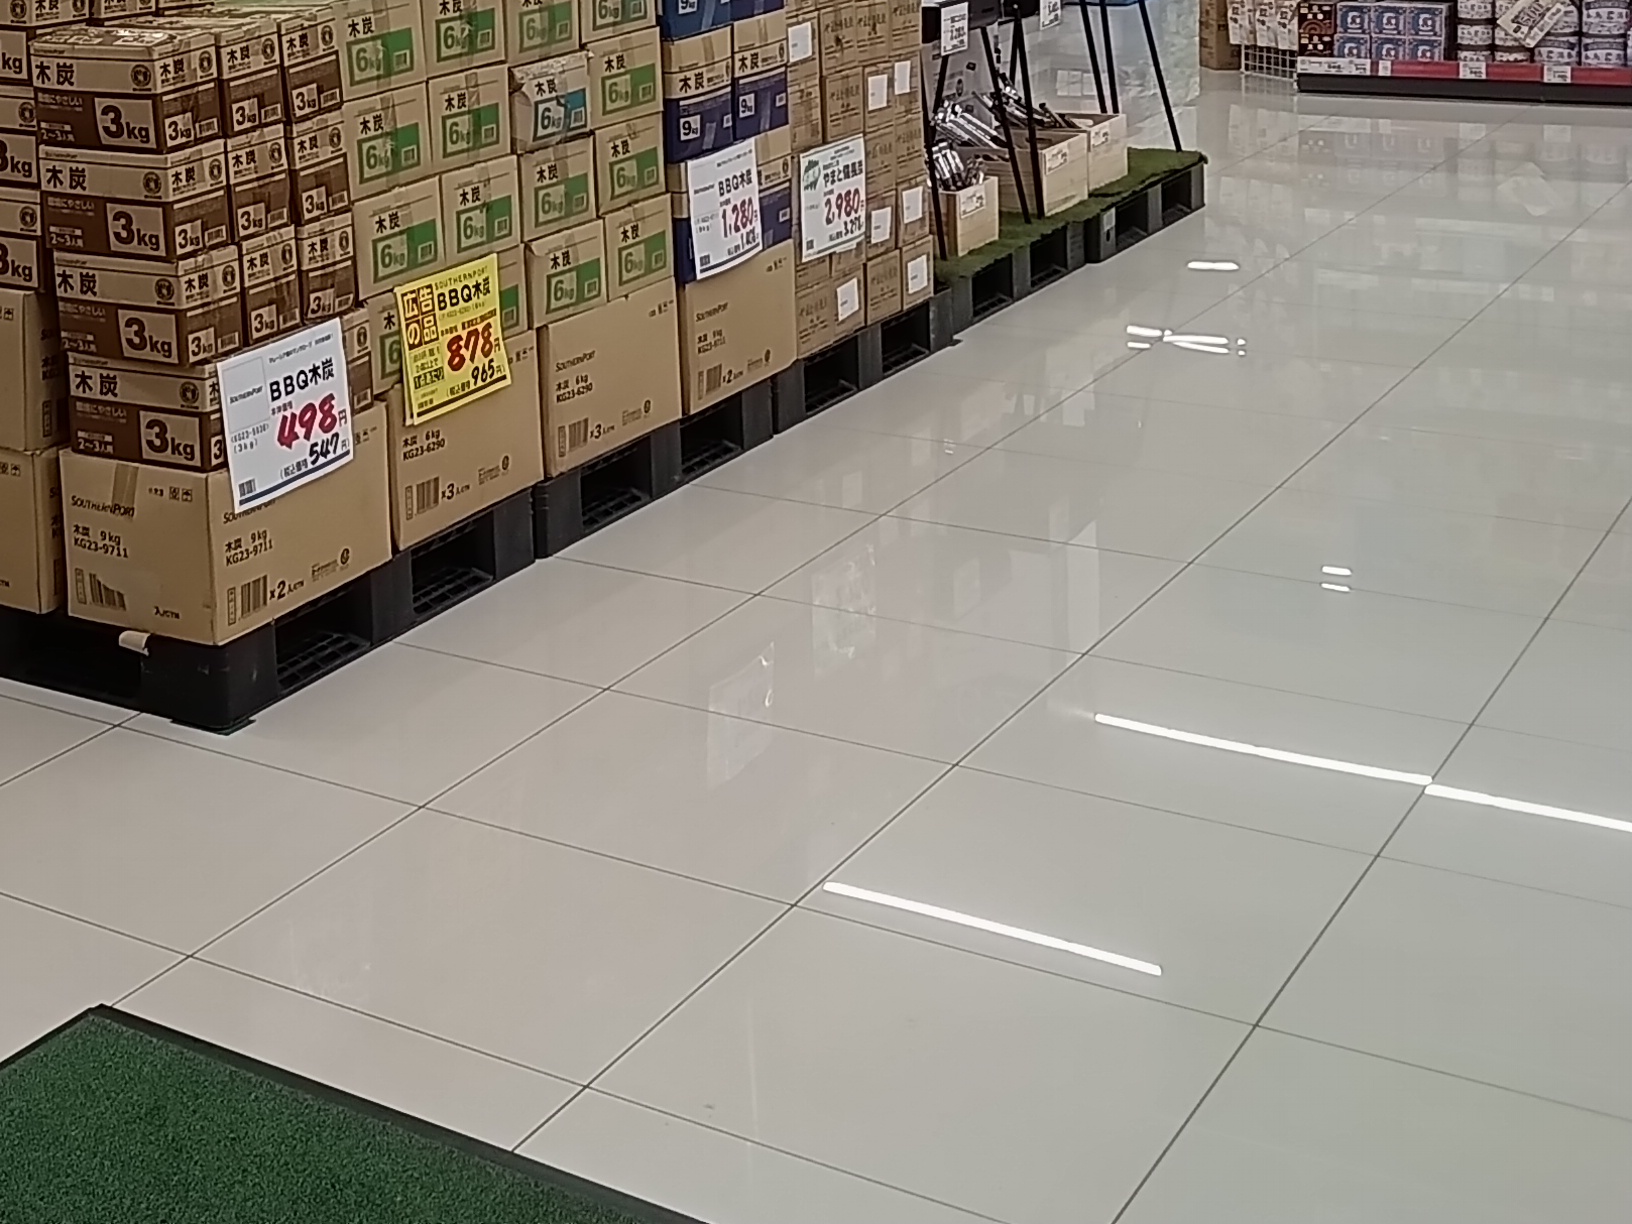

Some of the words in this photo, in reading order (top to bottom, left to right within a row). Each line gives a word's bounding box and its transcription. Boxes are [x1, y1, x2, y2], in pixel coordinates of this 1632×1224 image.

[35, 61, 75, 86] 木炭
[100, 104, 150, 143] 3kg
[45, 165, 87, 192] 木炭
[375, 212, 401, 233] 木炭
[825, 188, 860, 225] 2,980
[112, 211, 160, 250] 3kg
[57, 272, 97, 297] 木炭
[437, 276, 490, 310] BBQ木炭
[124, 317, 173, 359] 3kg
[447, 322, 493, 371] 878
[75, 370, 118, 397] 木炭
[269, 357, 334, 402] BBQ木炭
[472, 358, 495, 386] 965
[277, 393, 337, 449] 498
[145, 418, 195, 461] 3kg
[308, 432, 340, 465] 547
[225, 539, 273, 566] KG23-9711
